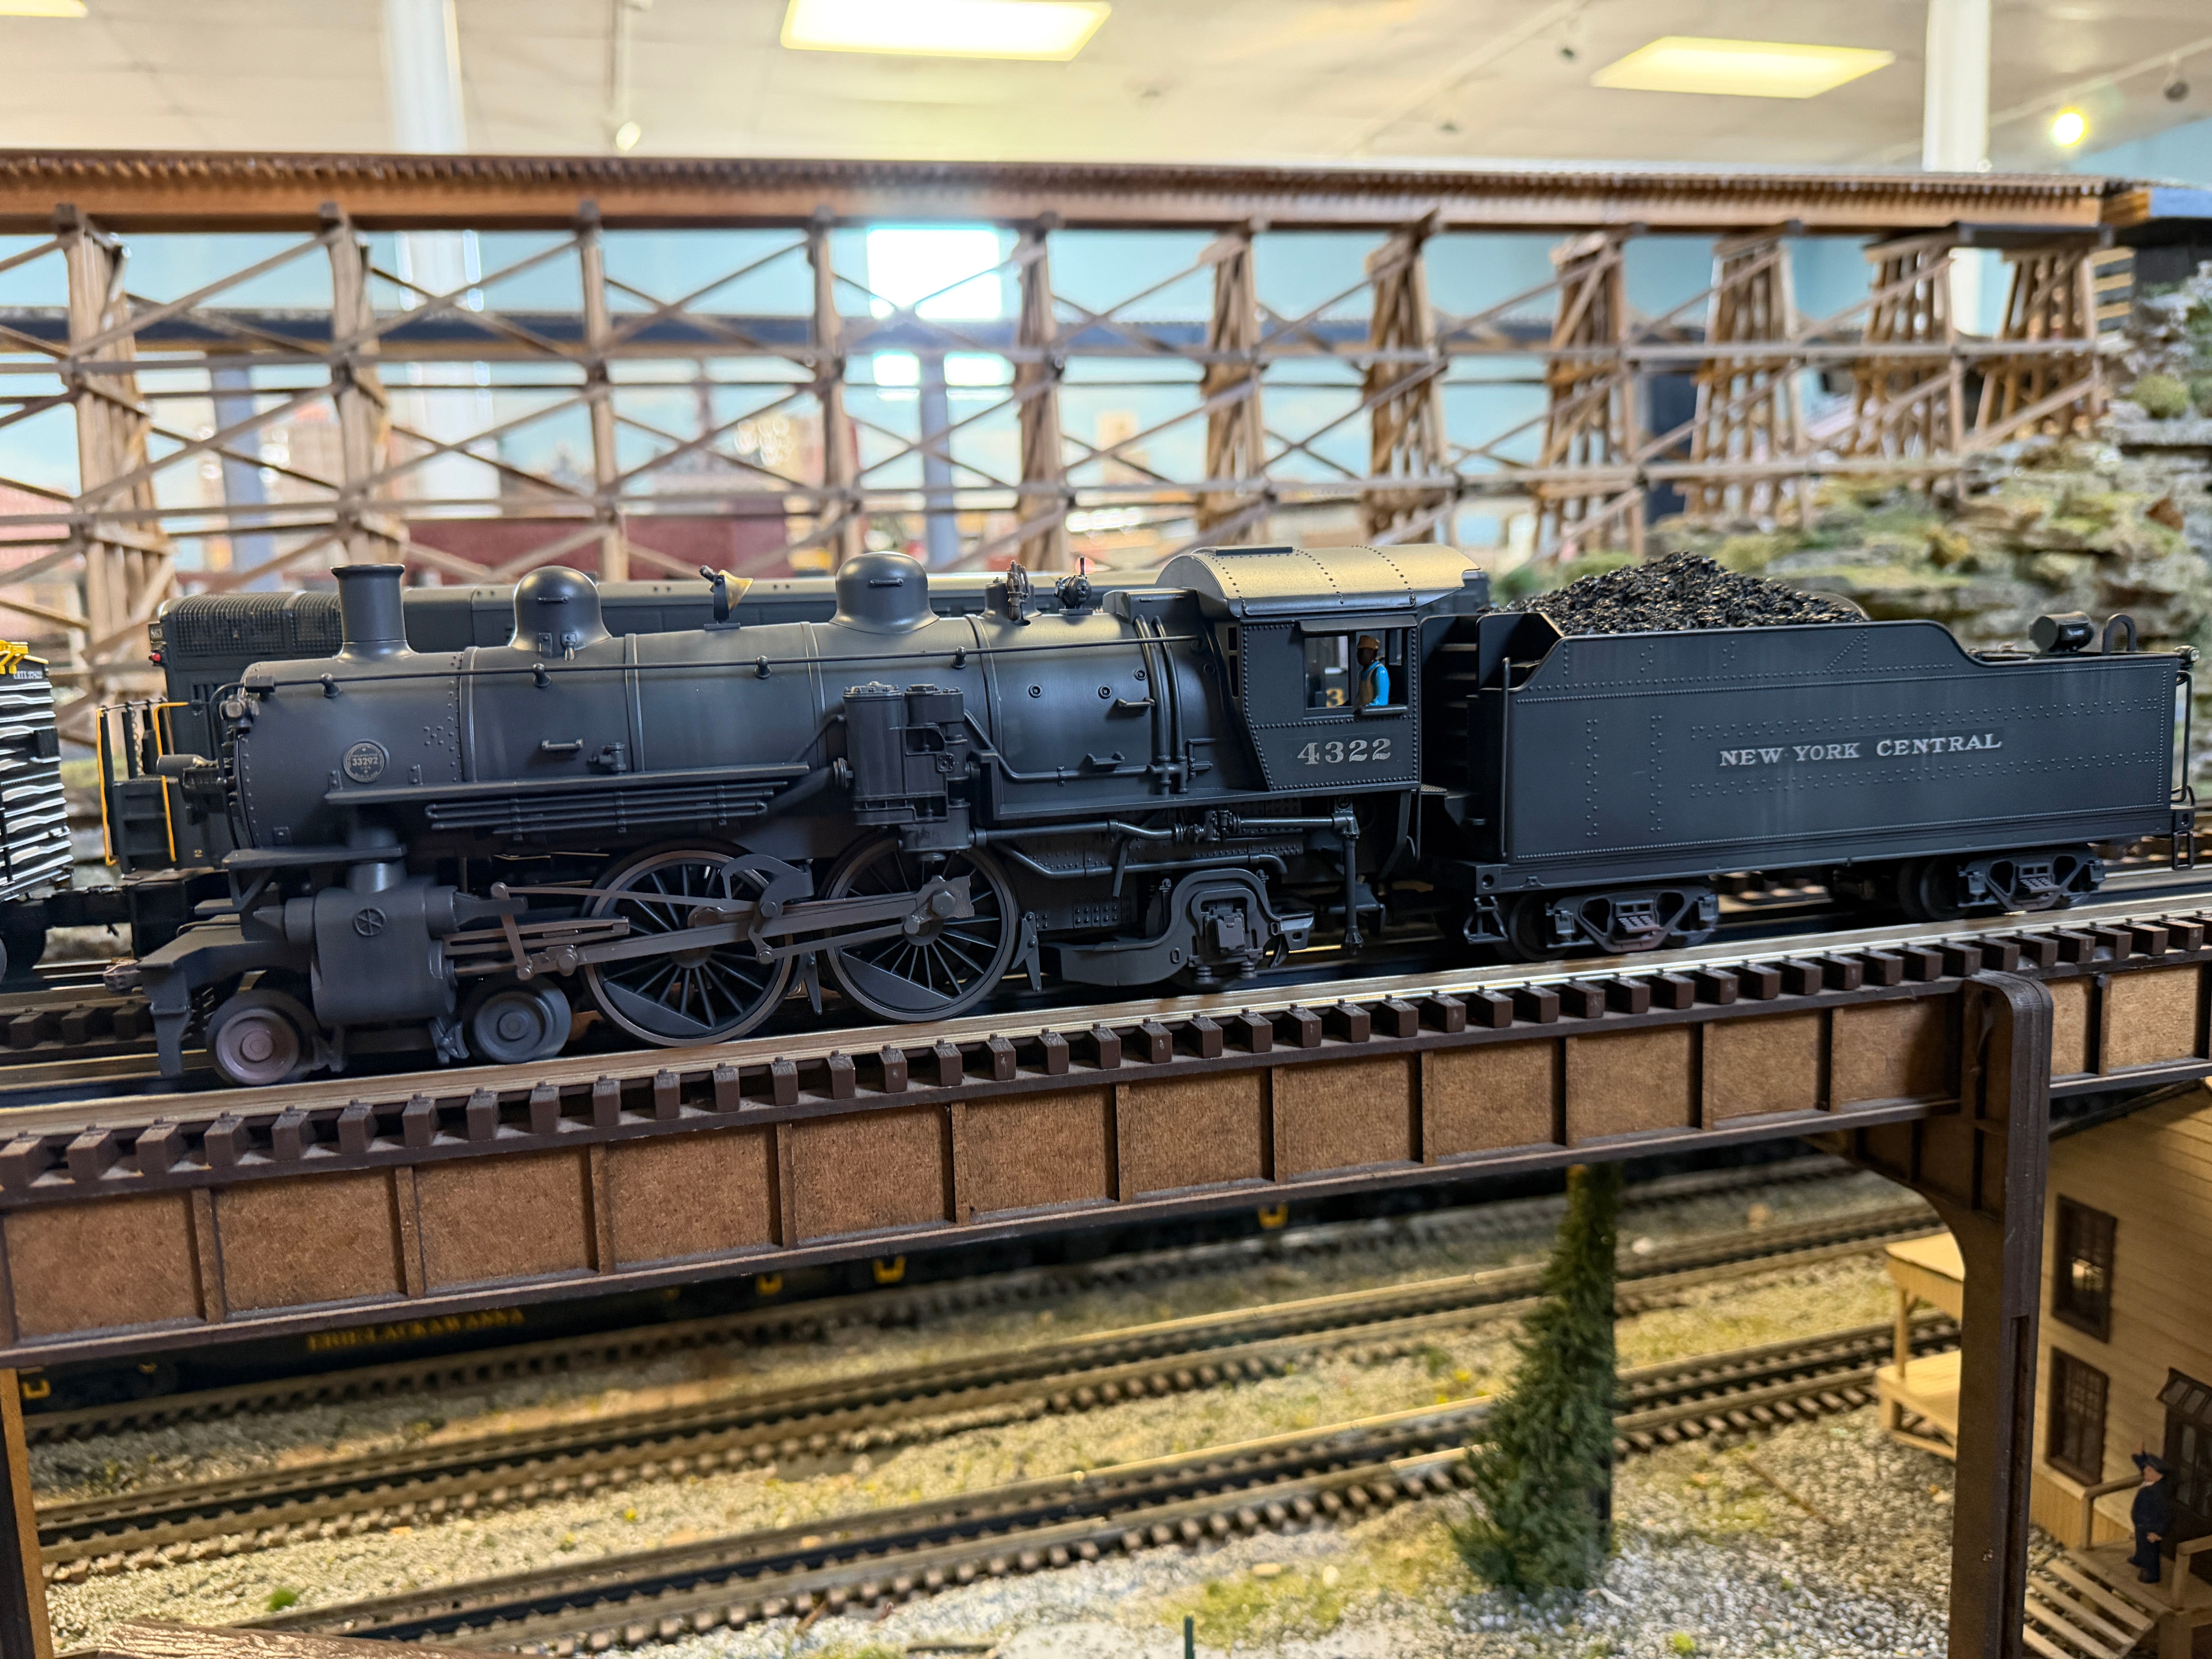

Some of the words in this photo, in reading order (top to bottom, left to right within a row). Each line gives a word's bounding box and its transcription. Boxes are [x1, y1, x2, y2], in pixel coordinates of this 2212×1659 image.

[1297, 738, 1391, 765] 4322
[1719, 747, 1784, 767] NEW
[1793, 742, 1860, 762] YORK
[1876, 733, 2002, 757] CENTRAL
